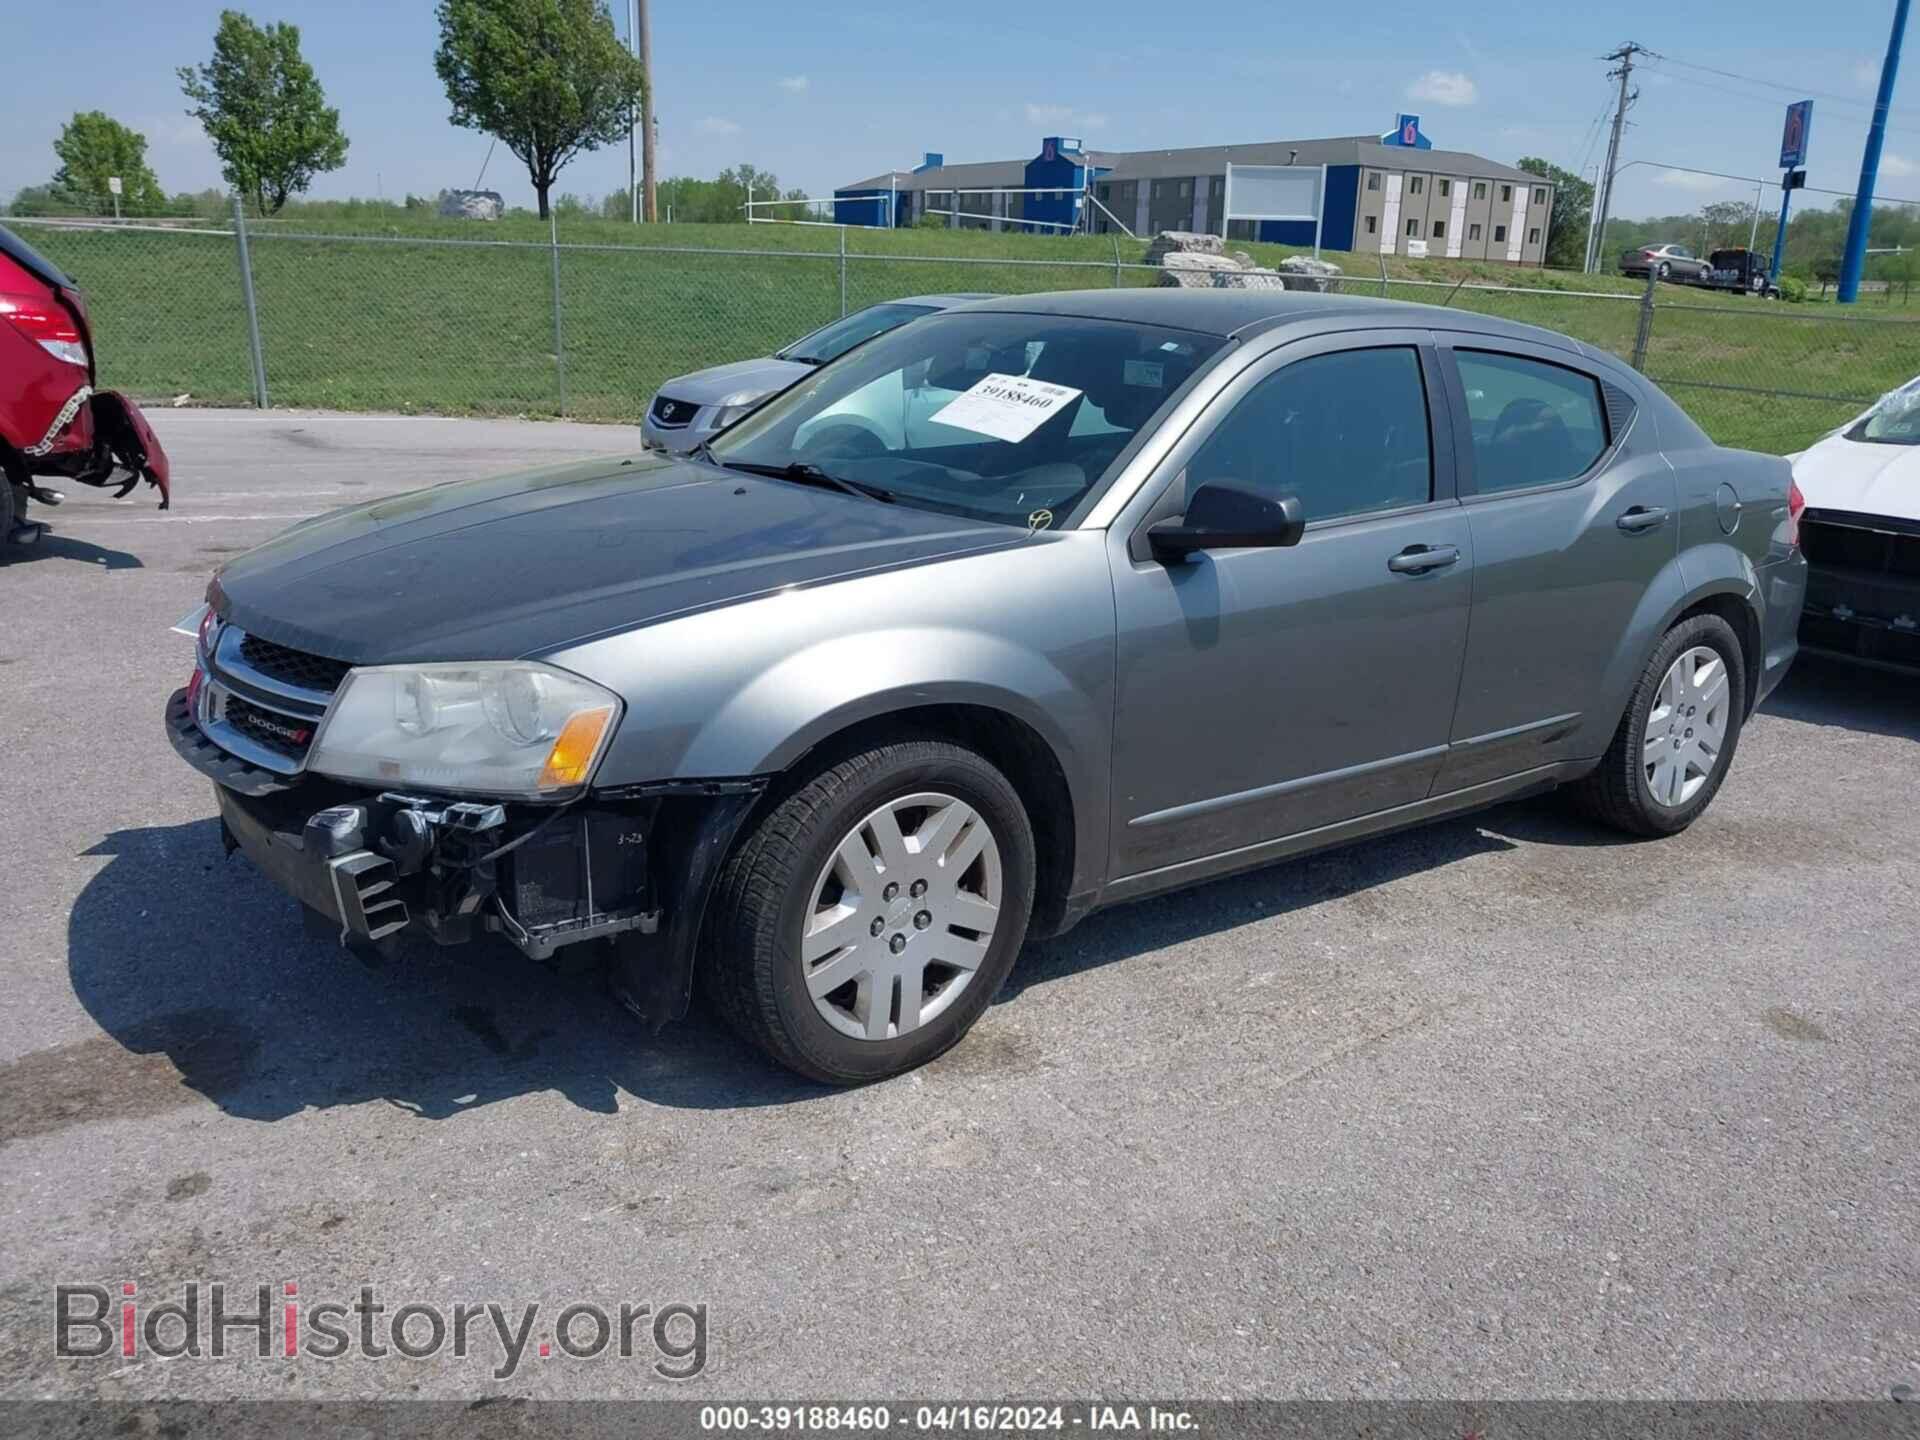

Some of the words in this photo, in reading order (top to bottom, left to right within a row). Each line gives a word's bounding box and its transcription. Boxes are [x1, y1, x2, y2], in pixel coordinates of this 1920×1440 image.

[1404, 120, 1417, 145] 6
[976, 385, 1054, 409] 39188460
[247, 713, 299, 740] DODGE
